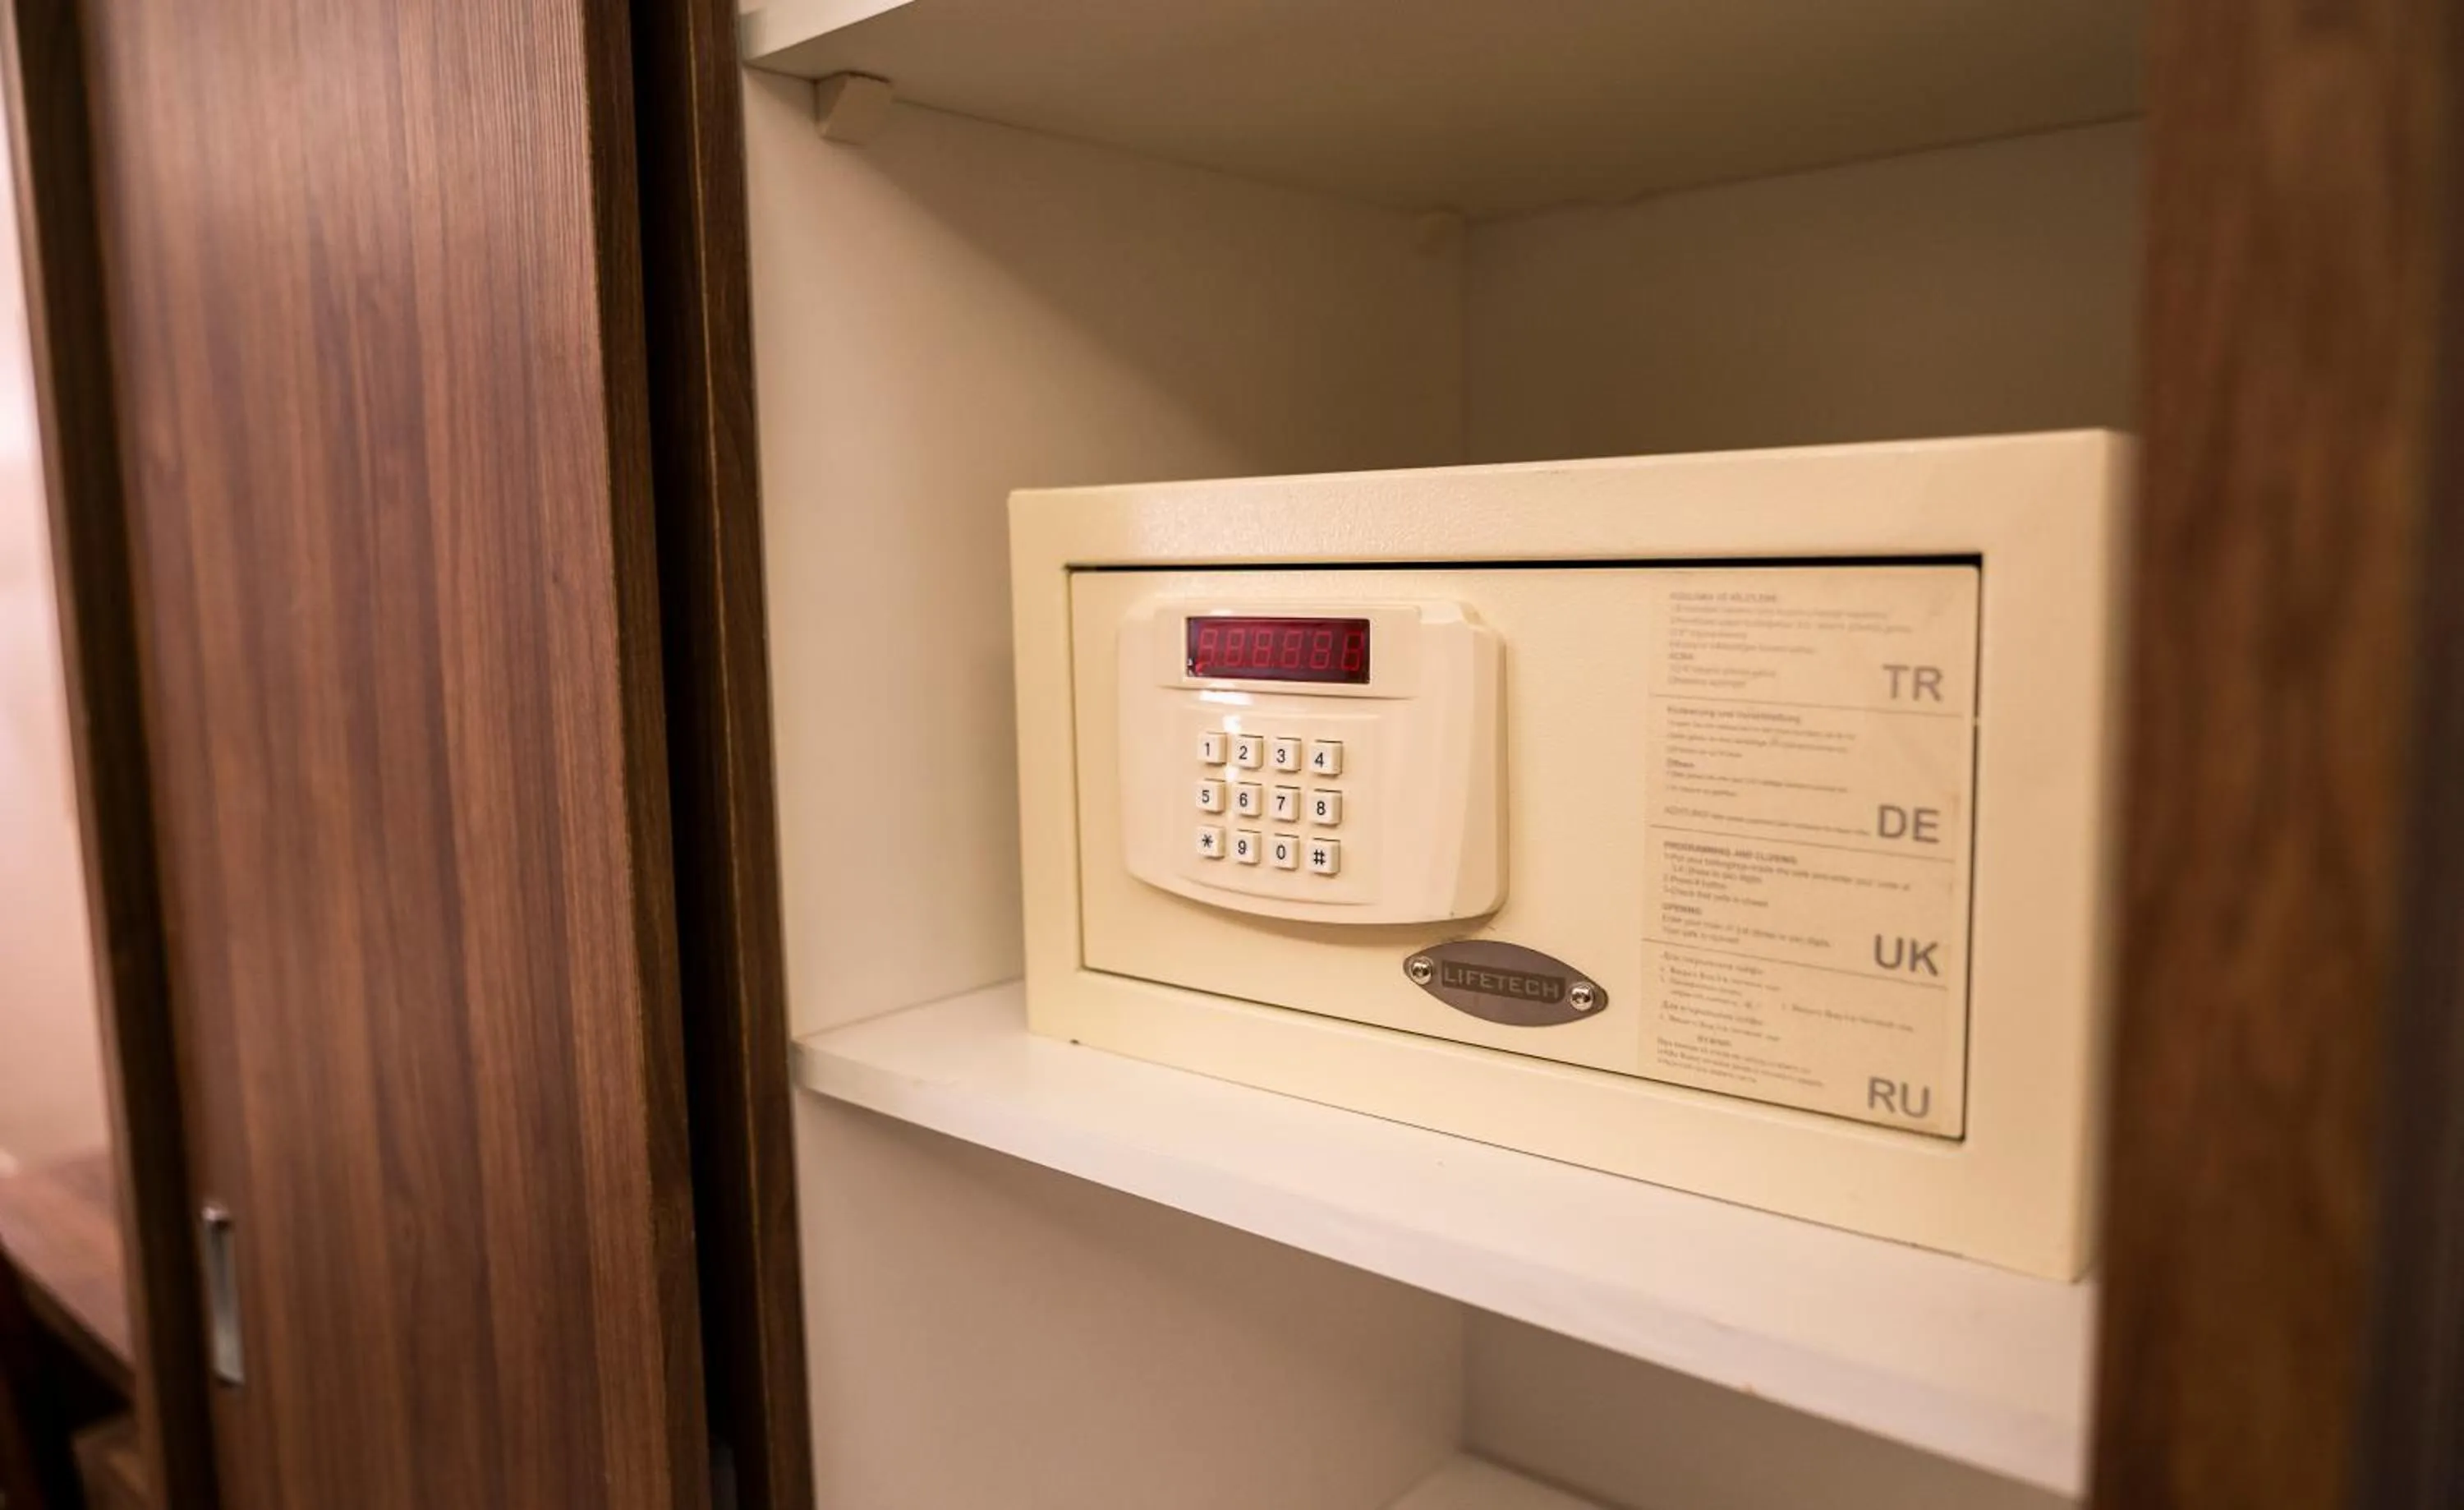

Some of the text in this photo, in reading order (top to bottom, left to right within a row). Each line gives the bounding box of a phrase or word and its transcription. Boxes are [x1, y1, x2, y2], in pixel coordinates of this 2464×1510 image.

[1882, 664, 1944, 702] TR
[1204, 742, 1211, 756] 1
[1238, 745, 1248, 760] 2
[1276, 748, 1285, 763] 3
[1314, 752, 1324, 767] 4
[1202, 789, 1210, 804] 5
[1239, 792, 1248, 808] 6
[1276, 795, 1285, 810] 7
[1316, 800, 1326, 816] 8
[1878, 804, 1940, 844] DE
[1238, 839, 1248, 855] 9
[1276, 844, 1286, 860] 0
[1873, 933, 1939, 977] UK
[1444, 966, 1561, 999] LIFETECH
[1867, 1076, 1930, 1118] RU
